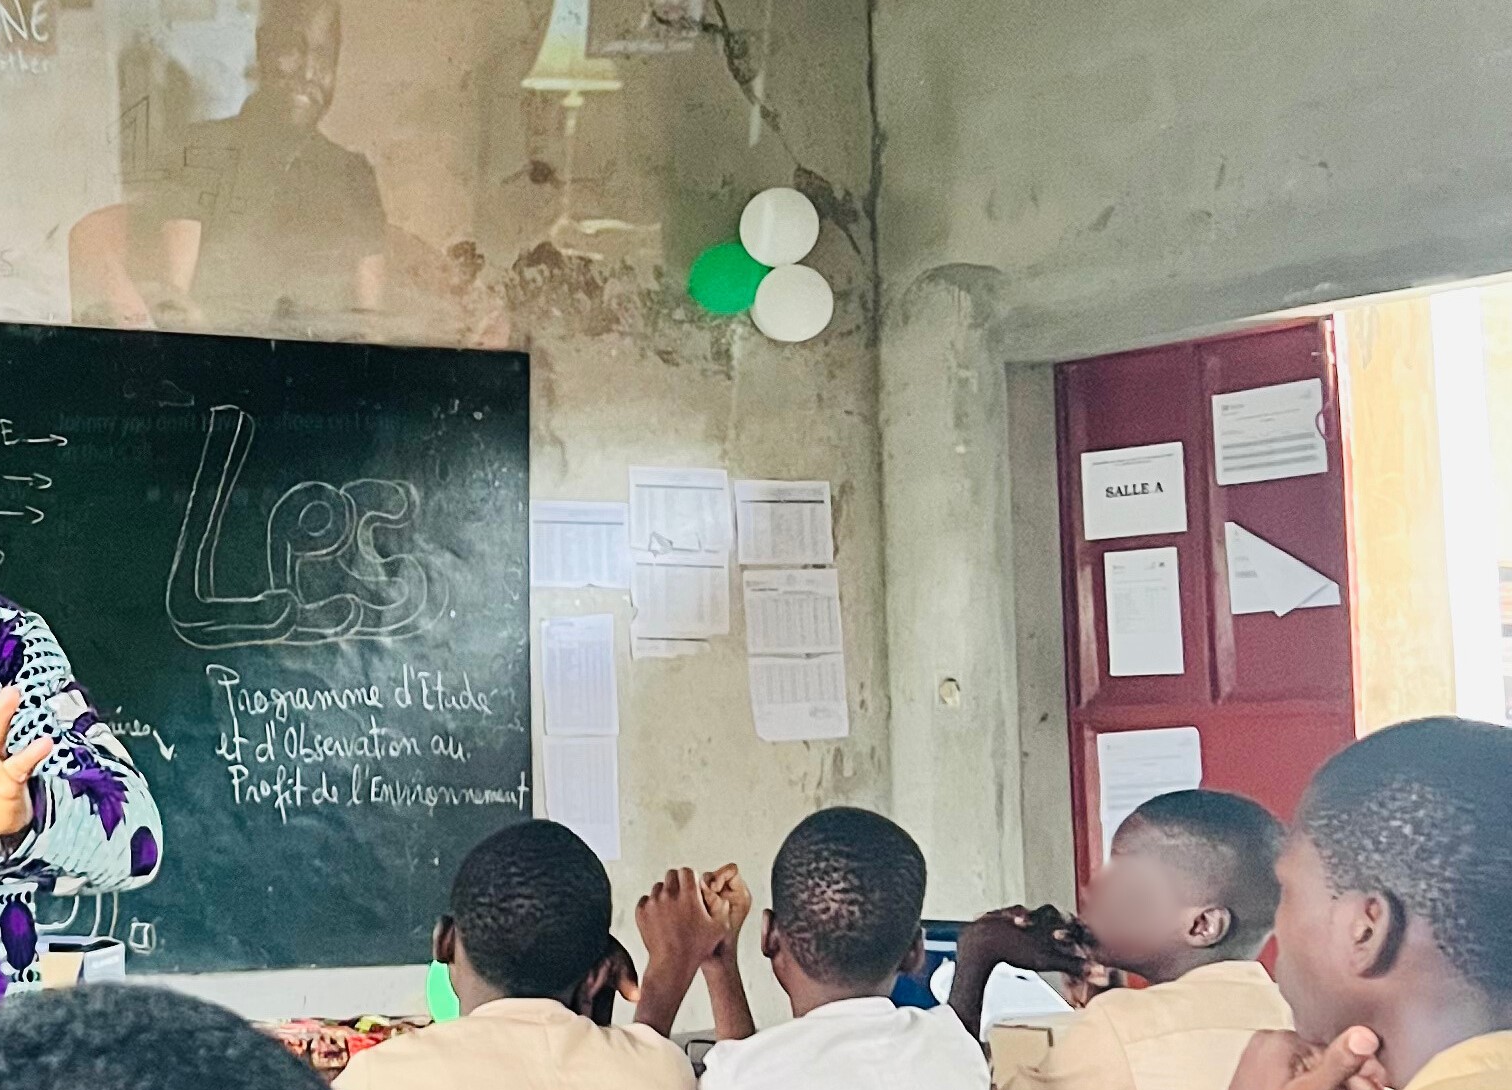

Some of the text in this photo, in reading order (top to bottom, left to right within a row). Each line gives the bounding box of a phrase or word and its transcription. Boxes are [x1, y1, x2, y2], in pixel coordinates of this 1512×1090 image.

[1105, 481, 1164, 498] SALLE A
[166, 404, 450, 648] Les
[205, 663, 384, 724] Programme
[215, 720, 250, 763] et
[255, 714, 422, 764] d'Observation
[227, 763, 308, 825] Profit
[311, 770, 339, 806] de
[347, 763, 530, 812] l'Environnement
